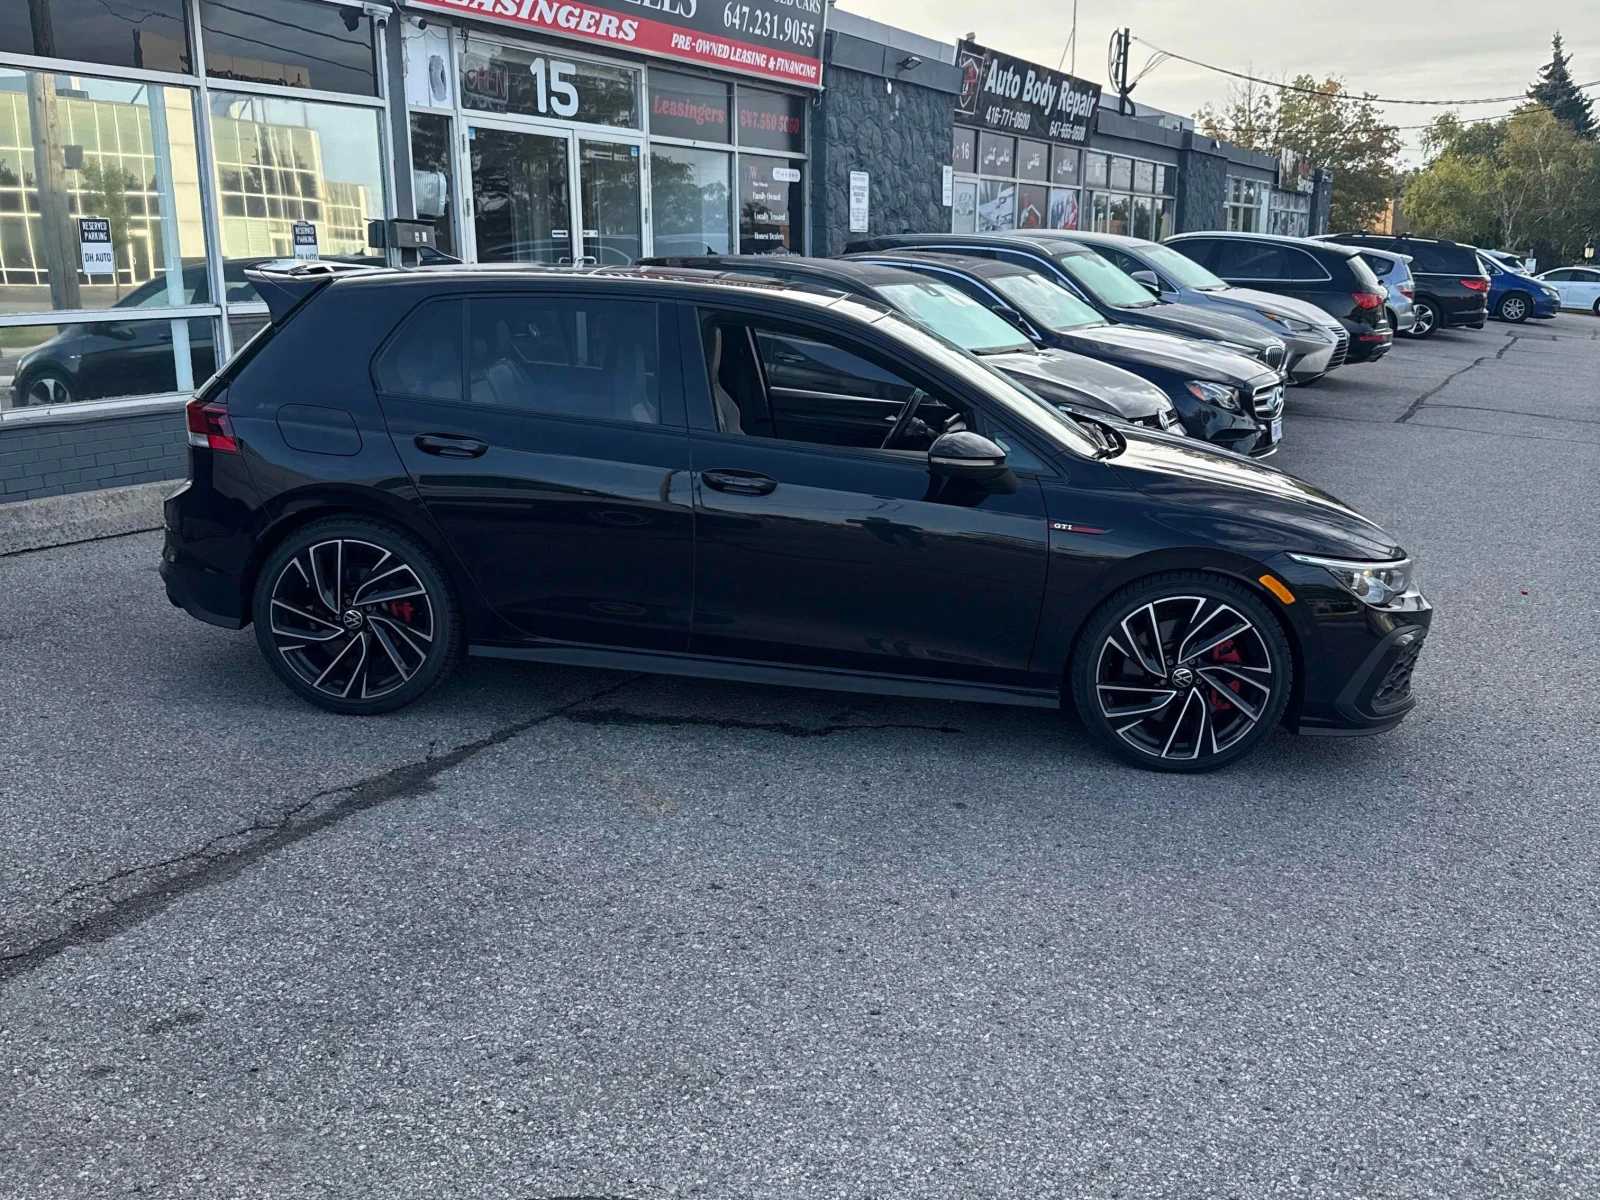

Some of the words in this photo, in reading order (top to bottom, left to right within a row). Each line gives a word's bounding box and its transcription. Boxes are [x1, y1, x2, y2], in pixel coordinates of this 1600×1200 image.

[438, 0, 639, 42] ASINGERS
[724, 1, 816, 48] 647.231.9055
[671, 33, 730, 60] PRE-OWNED
[730, 47, 766, 68] LEASING
[768, 58, 776, 71] &
[775, 59, 817, 79] FINANCING
[529, 57, 579, 117] 15
[984, 58, 1021, 99] Auto
[1022, 69, 1057, 115] Body
[1057, 80, 1097, 121] Repair
[653, 95, 725, 126] Leasingers
[961, 142, 970, 160] 16
[82, 221, 108, 231] RESERVED
[84, 231, 108, 241] PARKING
[95, 252, 112, 263] AUTO
[1053, 522, 1073, 530] GTI
